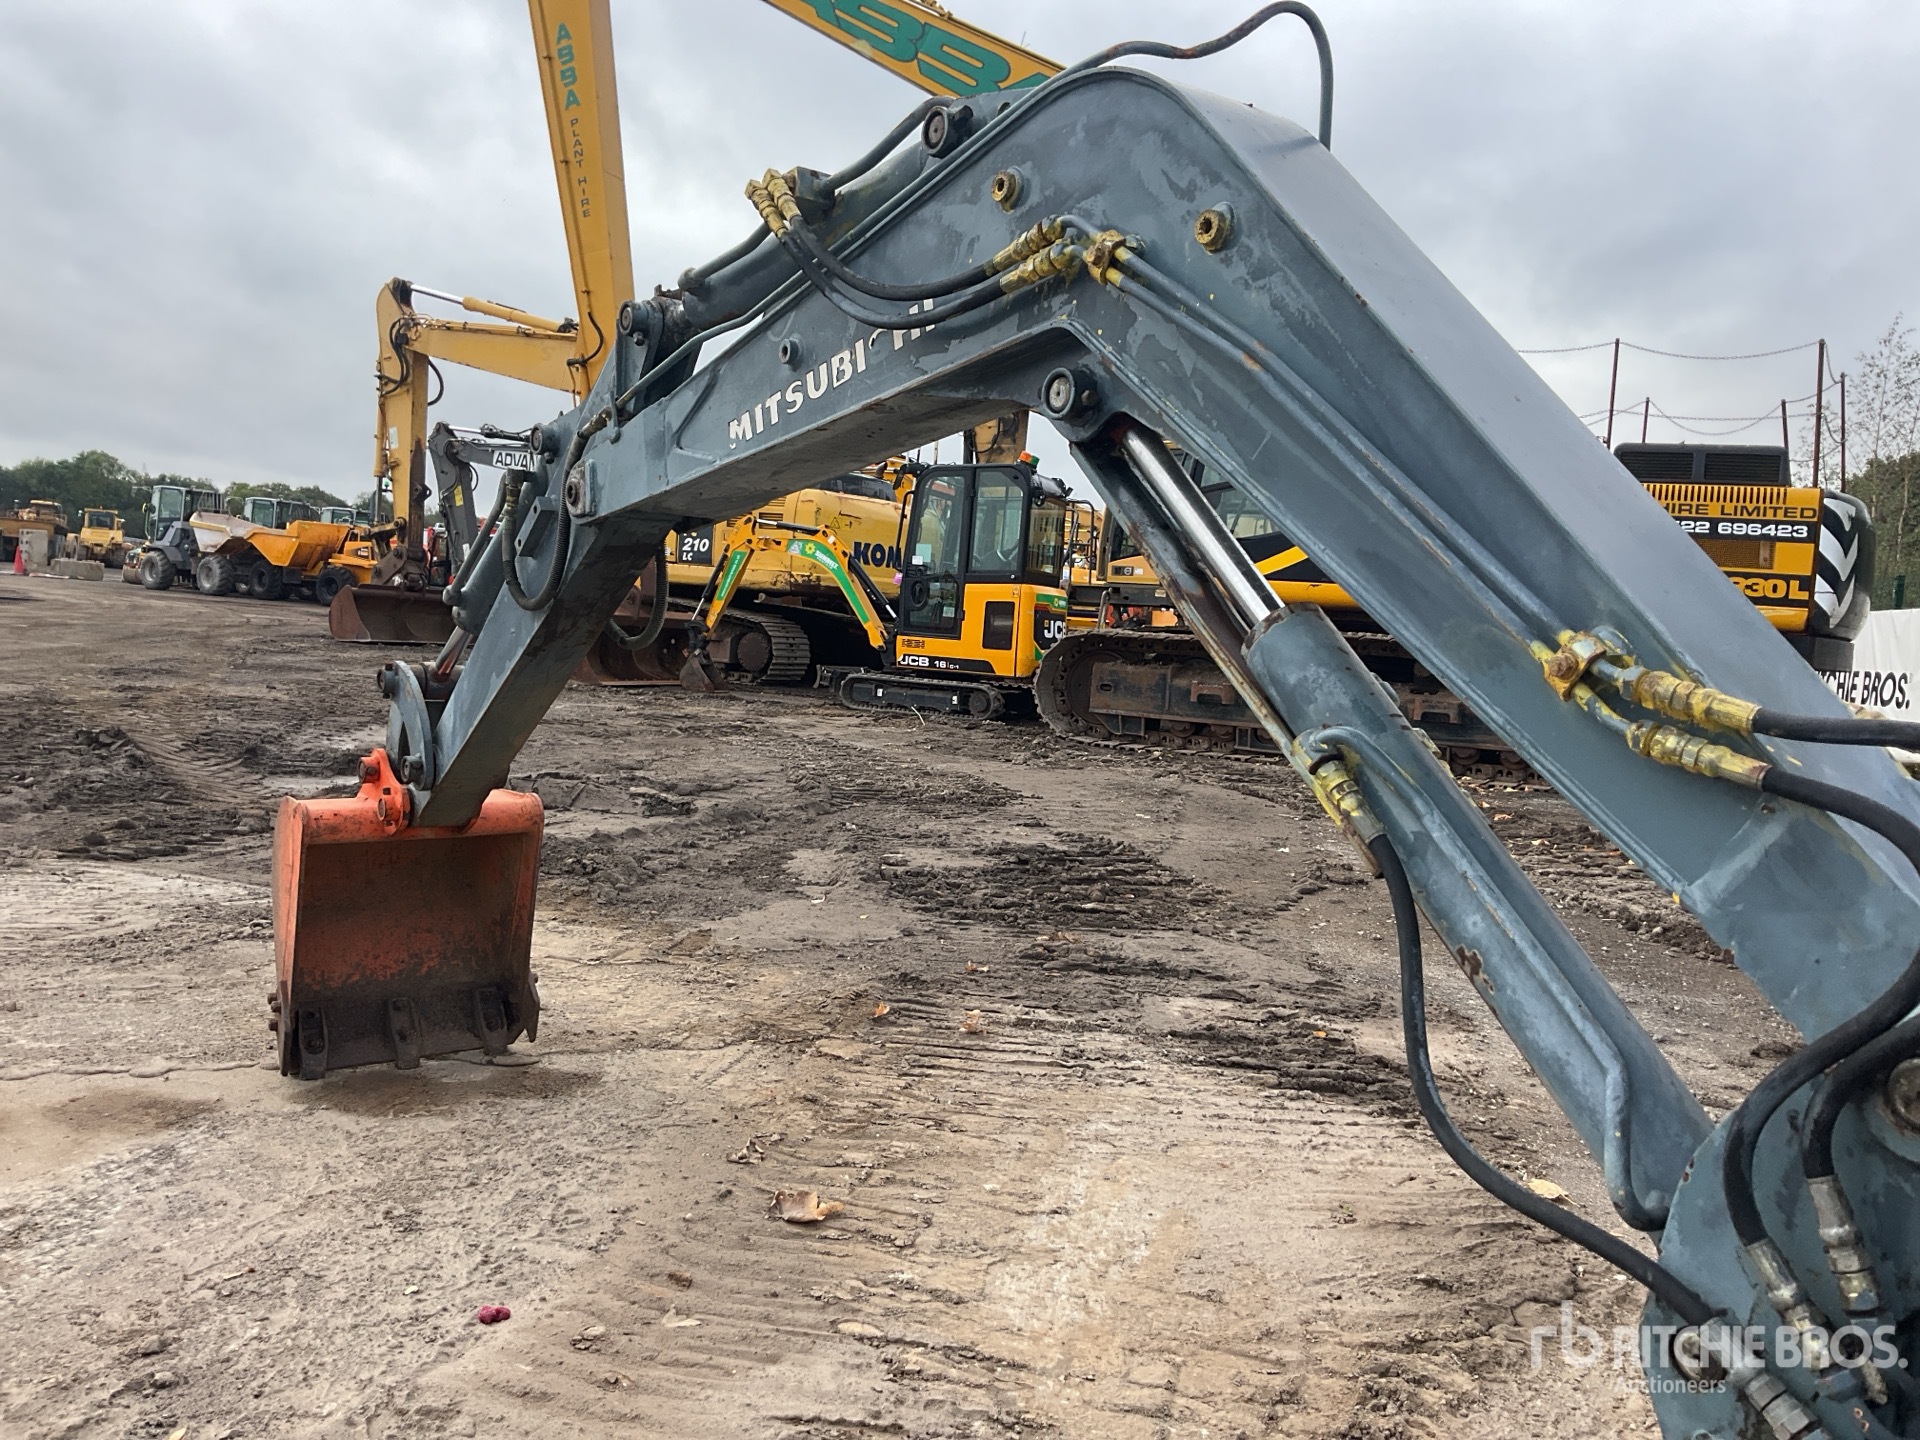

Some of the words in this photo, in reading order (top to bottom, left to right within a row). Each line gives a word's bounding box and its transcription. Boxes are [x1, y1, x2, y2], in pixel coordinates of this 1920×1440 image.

[803, 0, 1053, 98] BB
[556, 22, 581, 111] ABBA
[570, 118, 583, 168] PLANT
[578, 176, 590, 218] HIRE
[1720, 505, 1817, 519] LIMITED
[1676, 520, 1710, 533] 22
[1718, 522, 1808, 538] 696423
[682, 538, 710, 552] 210
[682, 552, 693, 561] LC
[900, 655, 930, 667] JCB
[1861, 671, 1910, 710] BROS.
